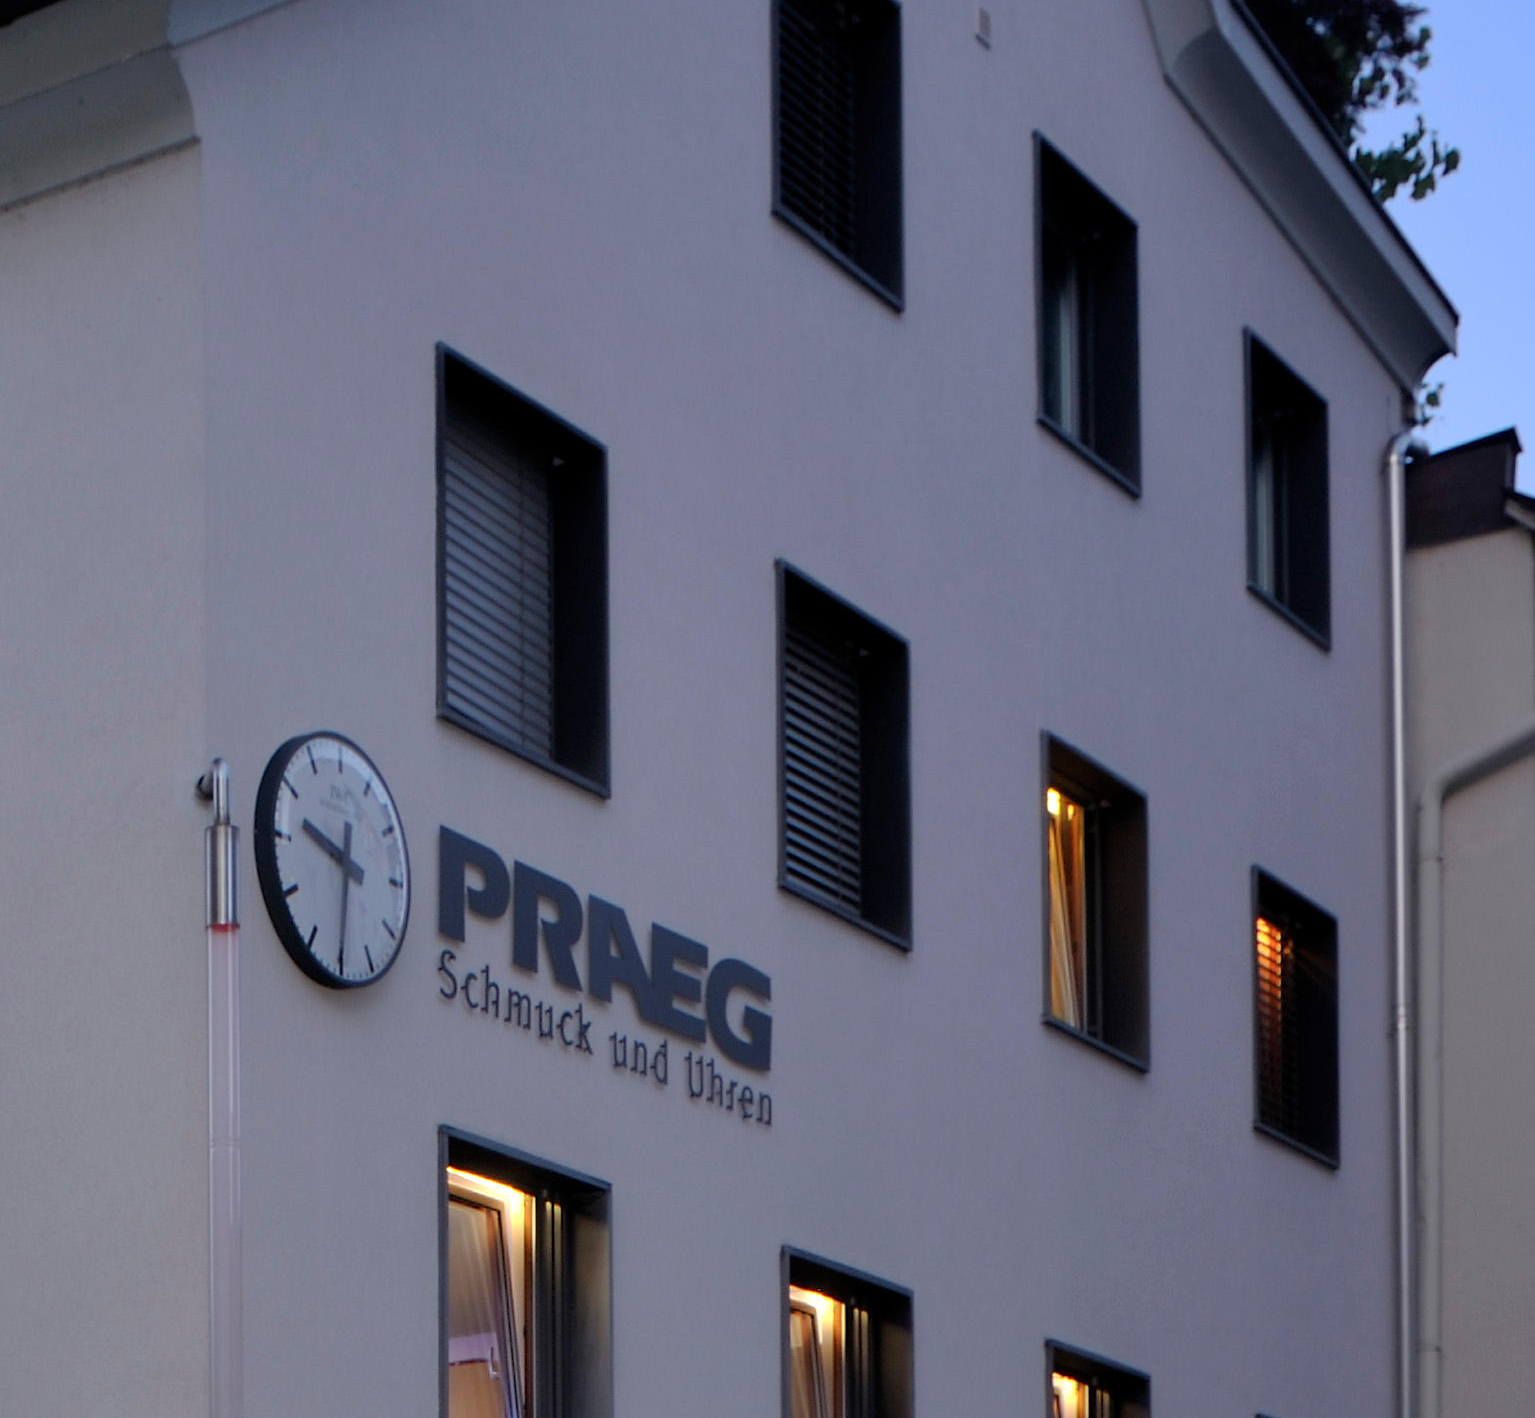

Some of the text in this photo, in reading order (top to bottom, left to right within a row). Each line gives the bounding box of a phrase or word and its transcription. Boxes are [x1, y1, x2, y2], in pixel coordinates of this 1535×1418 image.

[437, 948, 774, 1126] Schmuck und Uhren
[438, 824, 773, 1071] PRAEG
